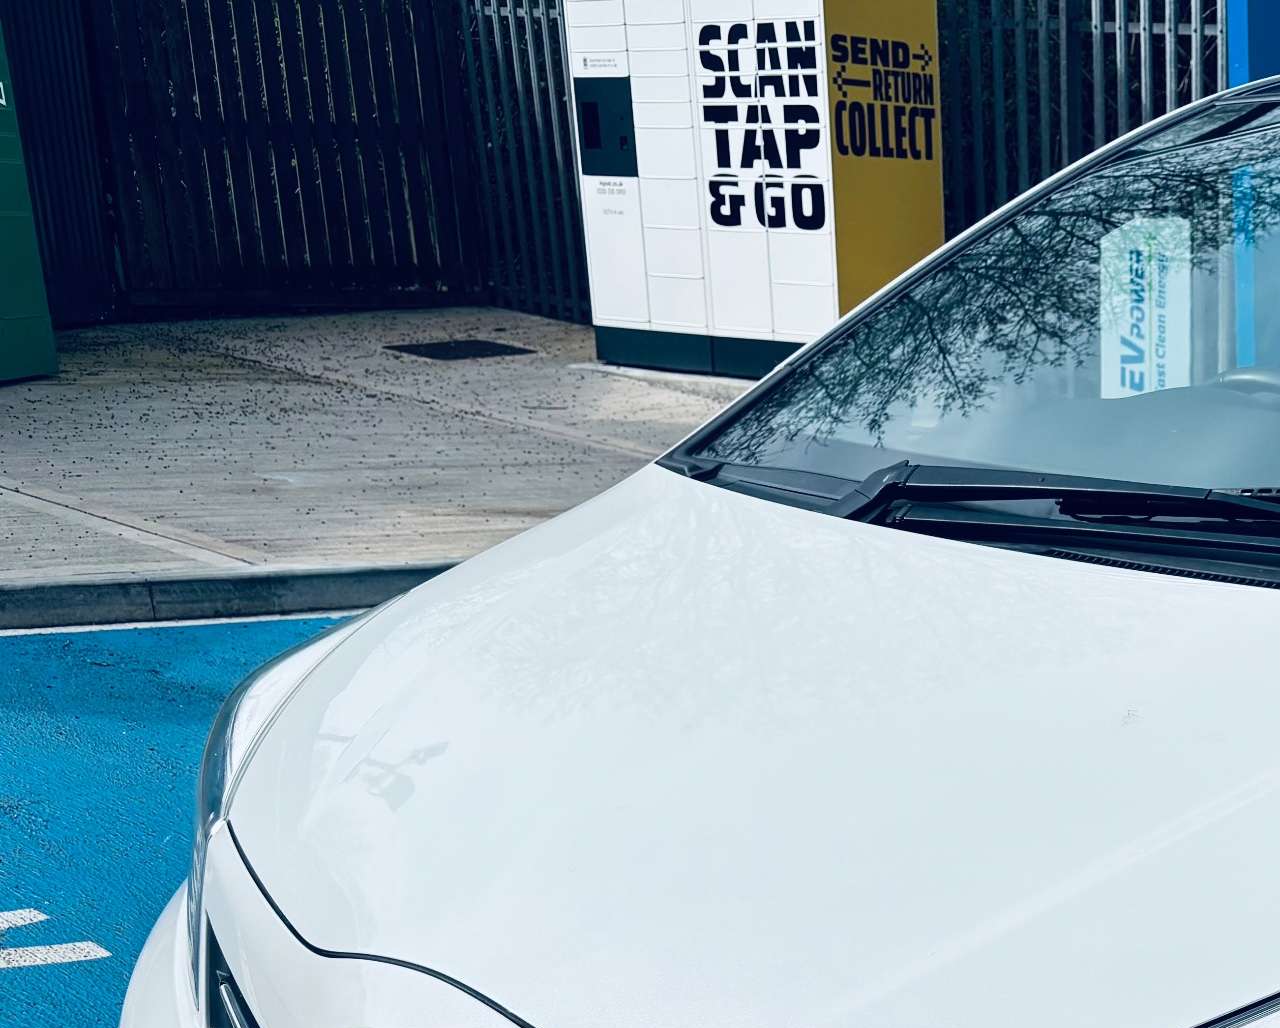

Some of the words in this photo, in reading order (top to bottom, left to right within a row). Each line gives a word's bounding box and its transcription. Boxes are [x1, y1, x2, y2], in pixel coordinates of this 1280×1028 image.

[699, 20, 819, 98] SCAN
[830, 34, 910, 69] SEND
[872, 68, 935, 105] RETURN
[702, 104, 820, 168] TAP
[834, 100, 935, 160] COLLECT
[708, 174, 746, 227] &
[754, 174, 826, 230] GO
[1154, 314, 1167, 359] Clean
